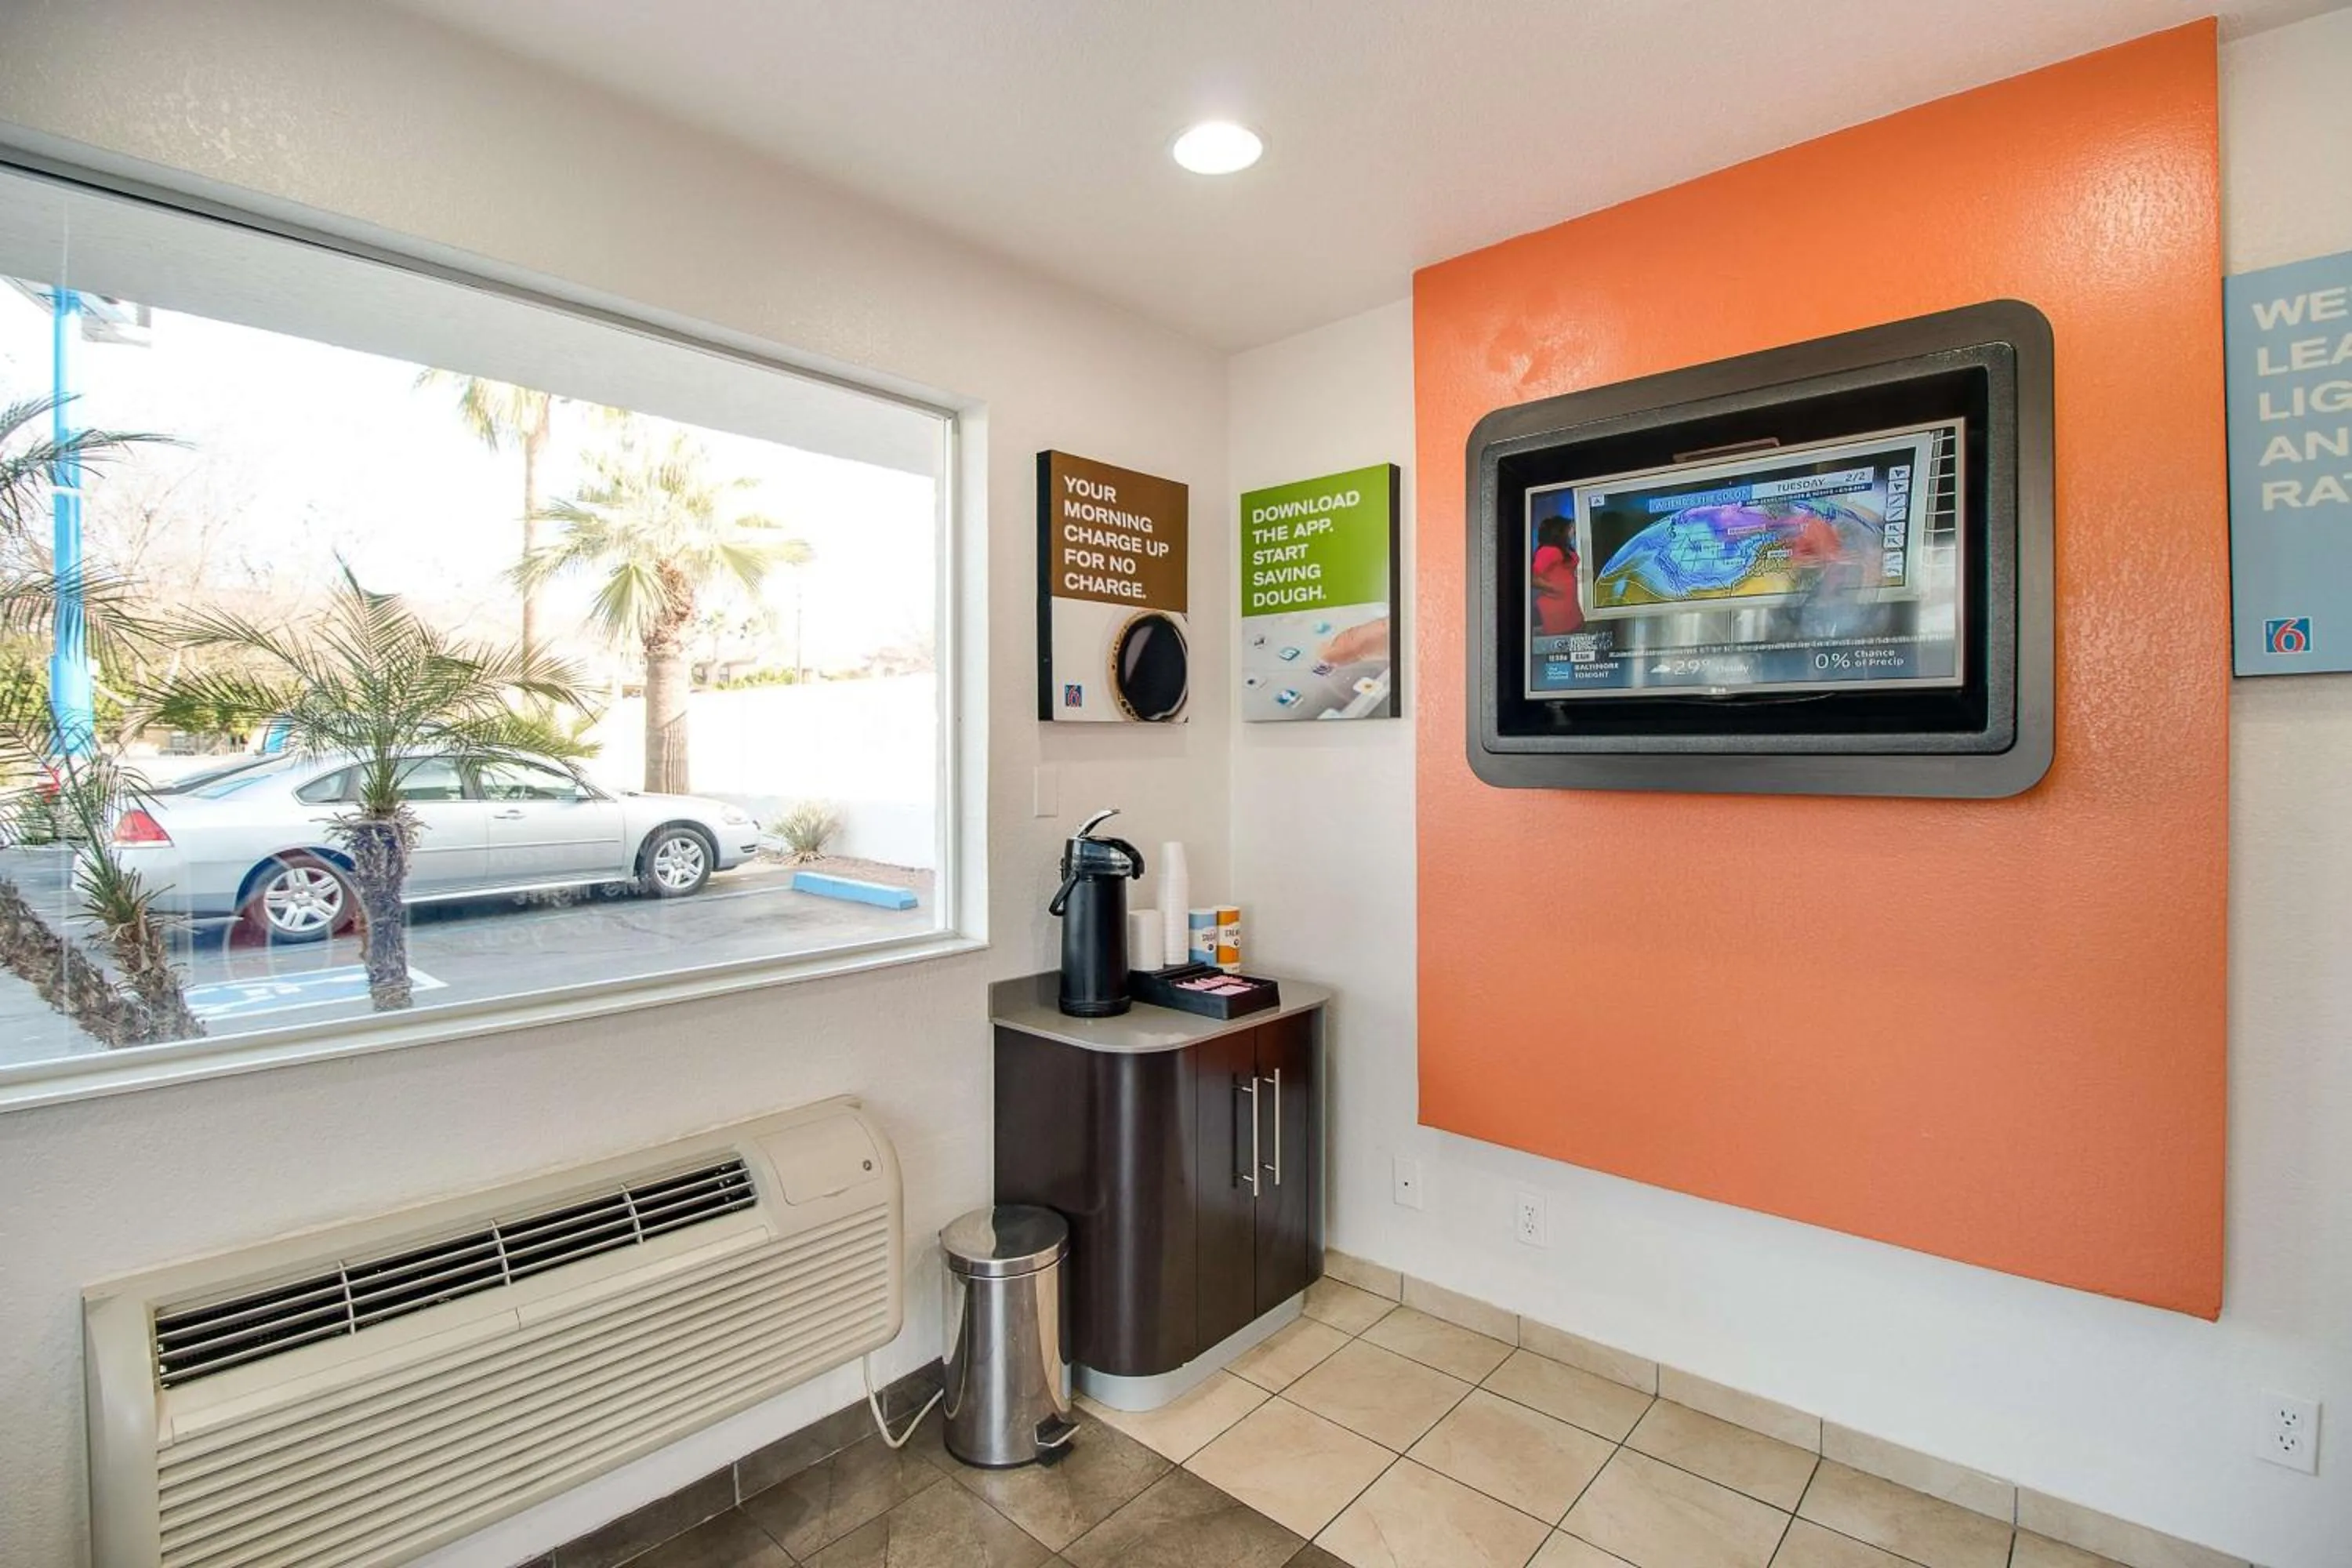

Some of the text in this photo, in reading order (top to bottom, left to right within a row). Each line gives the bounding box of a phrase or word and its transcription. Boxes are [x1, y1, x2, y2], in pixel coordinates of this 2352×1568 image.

[2252, 286, 2352, 331] WE
[1063, 474, 1117, 503] YOUR
[1776, 477, 1826, 493] TUESDAY
[1845, 471, 1866, 483] 2/2
[2262, 473, 2352, 511] RA
[1063, 499, 1153, 534] MORNING
[1252, 489, 1360, 524] DOWNLOAD
[1064, 524, 1170, 557] CHARGE UP
[1252, 517, 1334, 544] THE APP.
[1064, 548, 1136, 575] FOR NO
[1252, 543, 1309, 565] START
[1064, 572, 1147, 600] CHARGE.
[1252, 564, 1321, 586] SAVING
[1253, 584, 1327, 608] DOUGH.
[2273, 618, 2306, 653] 6
[1574, 662, 1619, 671] BALTIMORE
[1814, 652, 1851, 670] 0%
[1854, 649, 1896, 659] Chance
[1854, 656, 1905, 667] of Precip
